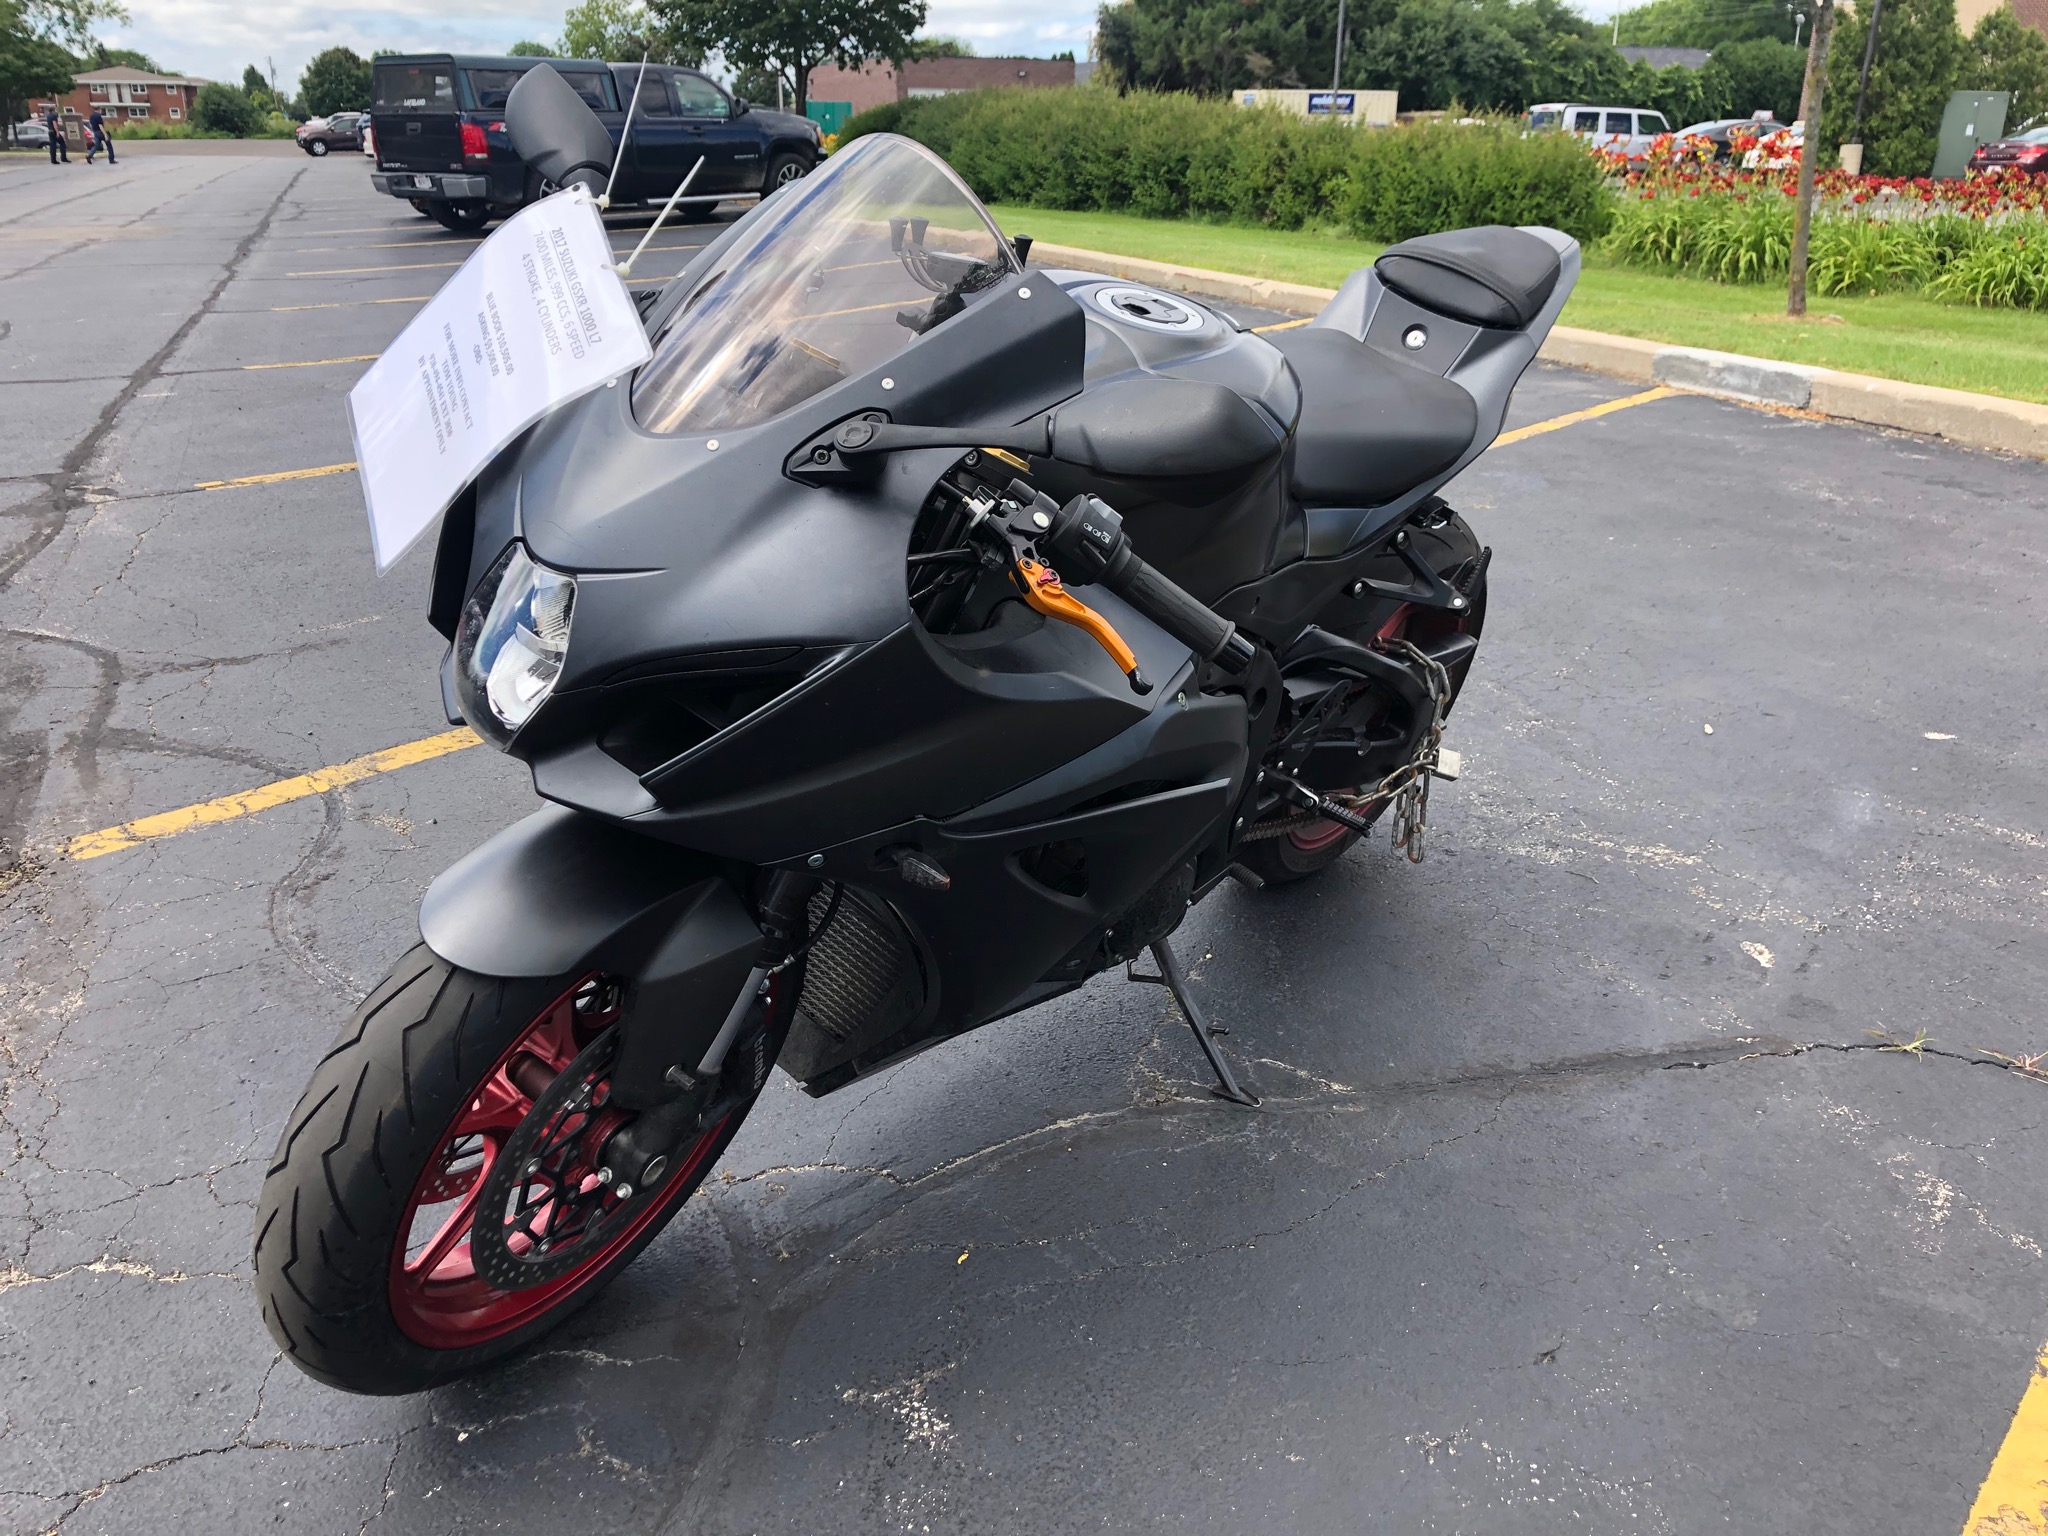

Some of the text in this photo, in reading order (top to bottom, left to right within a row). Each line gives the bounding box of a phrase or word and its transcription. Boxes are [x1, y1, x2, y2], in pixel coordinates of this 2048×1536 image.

[523, 259, 541, 294] STROKE
[538, 305, 561, 355] CYLINDERS
[534, 230, 584, 359] 7400 MILES, 999 CCS, 6 SPEED
[552, 227, 602, 343] 2017 SUZUKI GSXR 1000 L7
[443, 323, 473, 429] FOR MORE INFO CONTACT
[478, 312, 499, 376] ASKING $9,500.00
[486, 291, 514, 375] BLUE BOOK $10,505.00
[418, 355, 446, 454] BY APPOINTMENT ONLY
[440, 399, 449, 418] EXT
[442, 359, 458, 411] TOM YOUNG
[753, 1032, 767, 1090] brembo
